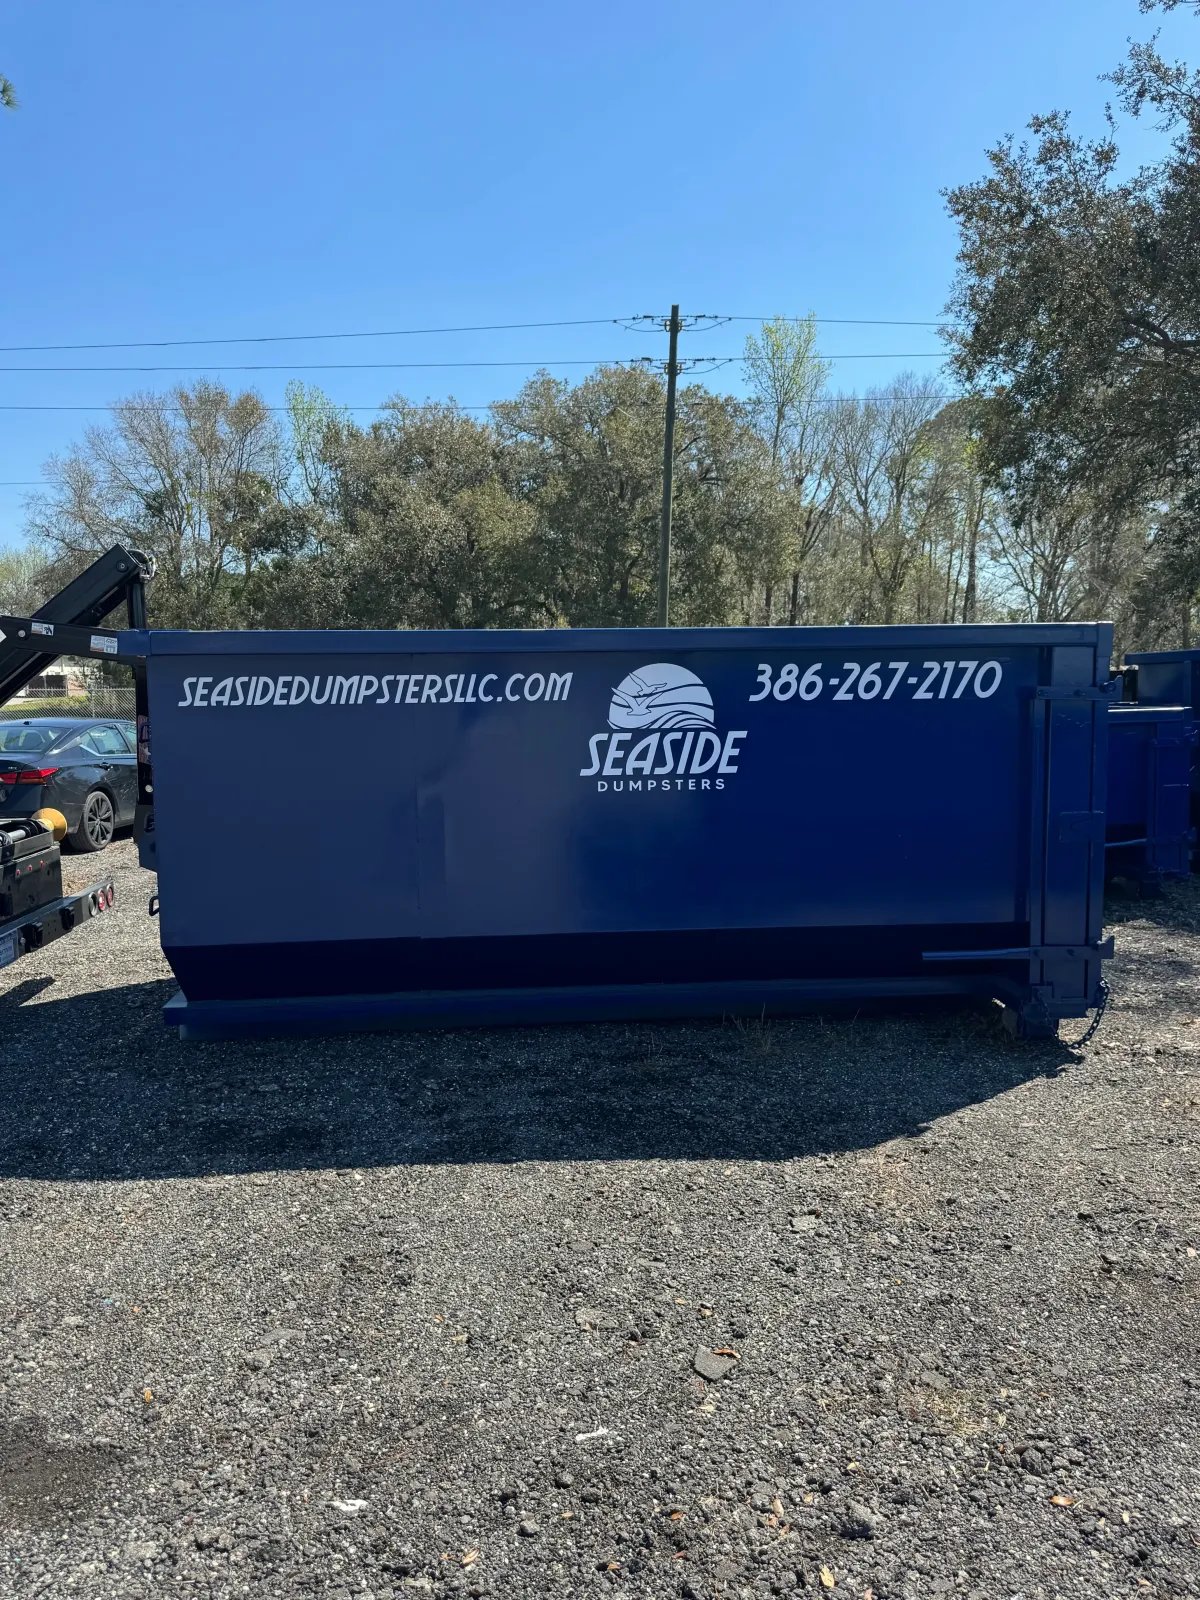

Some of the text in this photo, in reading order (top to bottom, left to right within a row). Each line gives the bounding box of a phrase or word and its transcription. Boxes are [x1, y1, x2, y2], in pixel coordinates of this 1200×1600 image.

[178, 672, 573, 706] SEASIDEDUMPSTERSLLC.COM
[749, 660, 1003, 702] 386-267-2170
[580, 730, 748, 777] SEASIDE
[597, 778, 725, 792] DUMPSTERS
